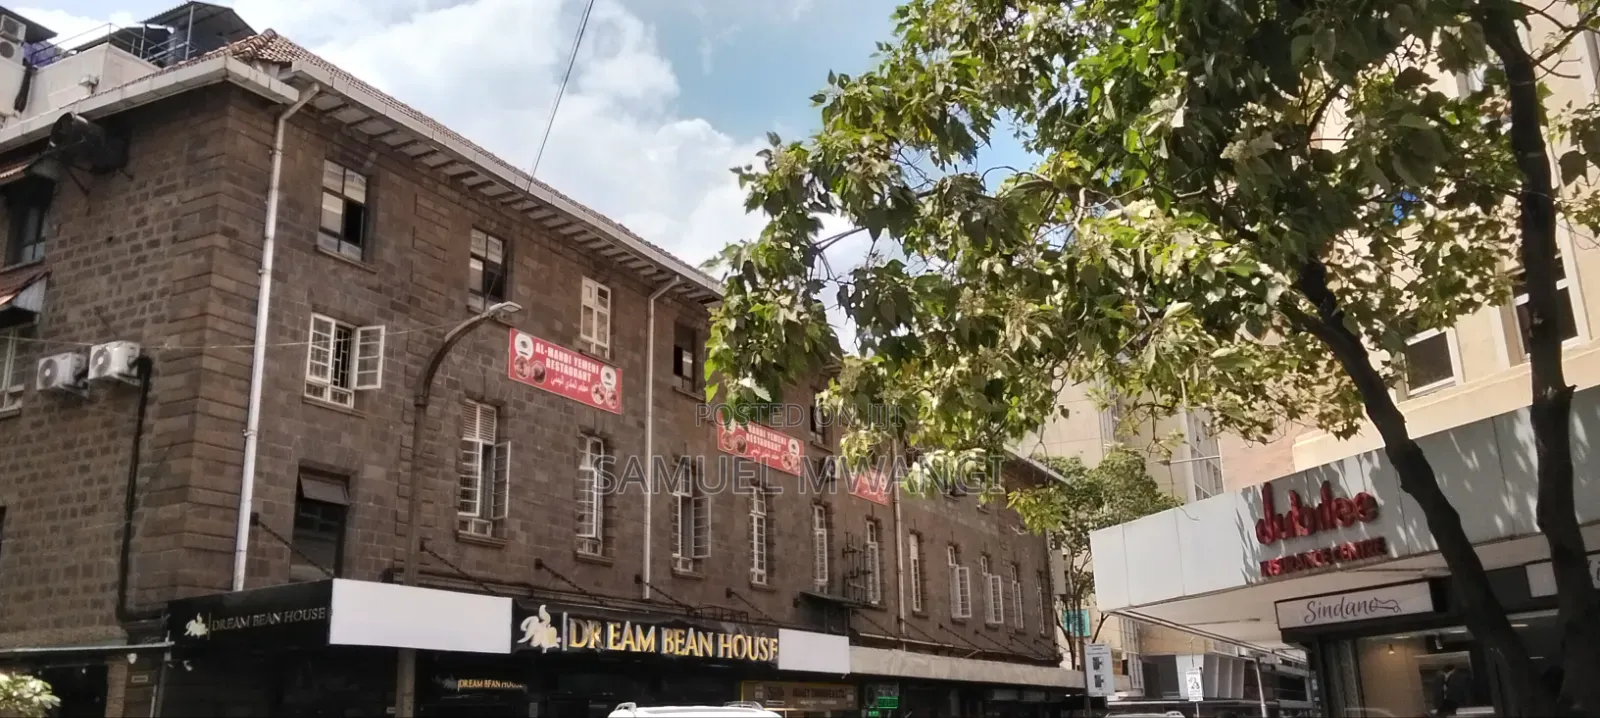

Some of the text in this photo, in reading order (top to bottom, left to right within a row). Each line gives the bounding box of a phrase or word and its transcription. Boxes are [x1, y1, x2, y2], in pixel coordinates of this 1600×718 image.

[545, 357, 592, 383] RESTAURANT
[573, 356, 599, 375] YEMENI
[745, 432, 781, 452] RESTAURANT
[1260, 536, 1388, 577] INSURANCE CENTRE
[212, 607, 326, 631] DREAM BEAN HOUSE
[1304, 597, 1382, 624] Sindano
[569, 618, 778, 662] DREAM BEAN HOUSE
[460, 679, 483, 688] DREAM
